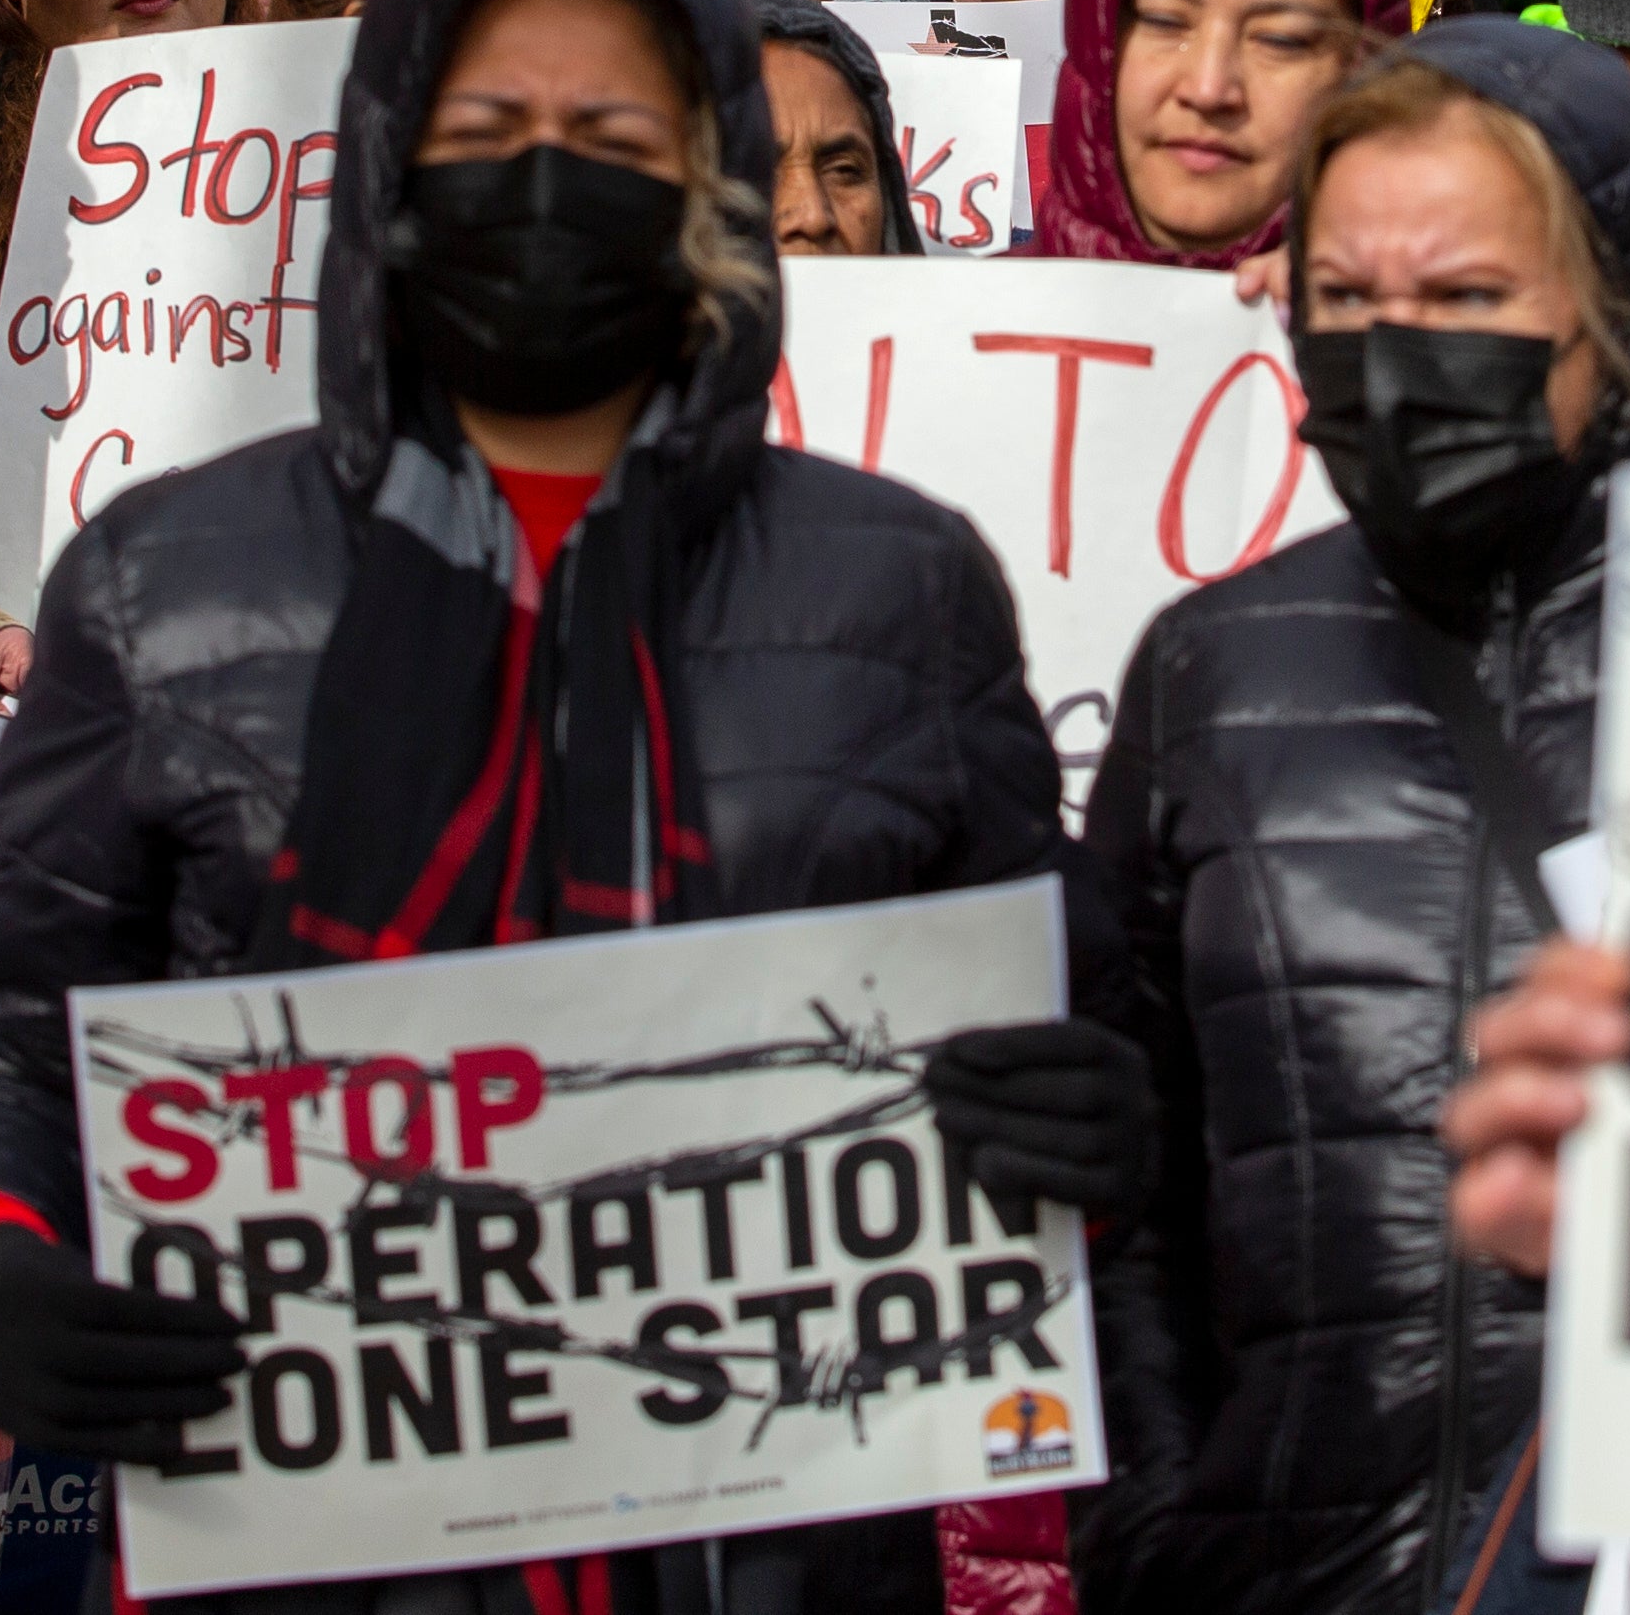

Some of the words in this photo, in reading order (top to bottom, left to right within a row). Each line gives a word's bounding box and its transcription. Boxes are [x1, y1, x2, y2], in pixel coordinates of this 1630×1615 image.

[70, 68, 336, 265] Stop
[8, 265, 318, 421] against
[121, 1044, 545, 1203] STOP
[638, 1256, 1060, 1425] STAR
